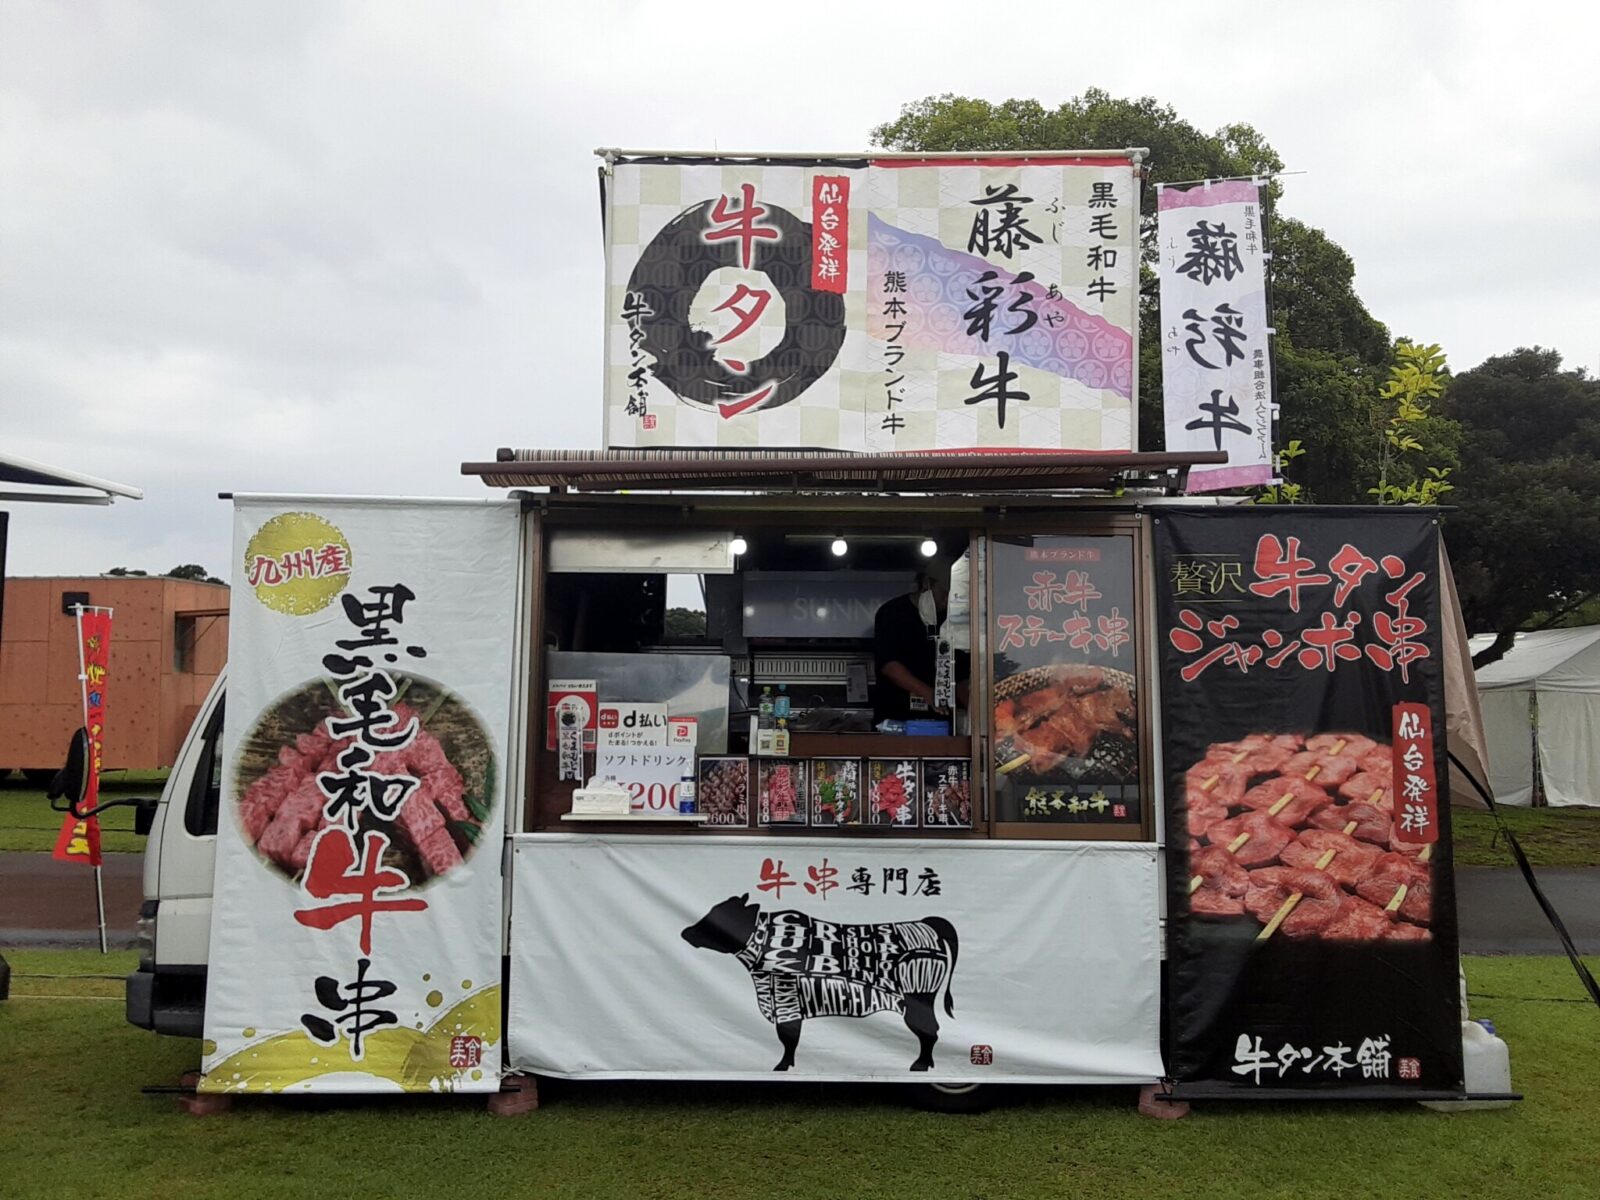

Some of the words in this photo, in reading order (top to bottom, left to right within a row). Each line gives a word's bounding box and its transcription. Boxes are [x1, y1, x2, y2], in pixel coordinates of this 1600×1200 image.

[817, 182, 842, 284] 仙台発祥
[1045, 197, 1066, 244] ふじ
[1086, 182, 1118, 302] 黒毛和牛
[704, 183, 778, 419] 牛タン
[963, 183, 1044, 430] 藤彩牛
[1044, 283, 1065, 328] あや
[620, 292, 653, 417] 牛タン本舗
[881, 270, 907, 435] 熊本ブランド牛
[248, 544, 350, 587] 九州産
[1023, 569, 1103, 613] 赤牛
[1170, 560, 1247, 597] 贅沢
[1249, 533, 1426, 613] 牛タン
[793, 597, 881, 621] SUNN
[997, 606, 1130, 658] ステーキ串
[1169, 598, 1430, 684] ジャンボ串
[623, 709, 668, 728] d払い
[605, 755, 687, 766] ソフトドリンク
[1398, 711, 1432, 836] 仙台発祥
[293, 583, 428, 1056] 黒毛和牛串
[617, 782, 681, 810] 200
[757, 858, 942, 900] 牛串専門店
[738, 917, 768, 969] NECK
[759, 912, 808, 973] CHUCK
[809, 920, 842, 974] RIB
[846, 926, 860, 978] SHORT
[860, 926, 875, 984] LOIN
[878, 924, 900, 991] SIRLOIN
[896, 922, 942, 952] RUMP
[753, 974, 774, 1022] SHANK
[774, 975, 802, 1024] BRISKET
[800, 977, 848, 1018] PLATE
[848, 982, 903, 1017] FLANK
[899, 958, 946, 994] ROUND
[1231, 1032, 1393, 1085] 牛タン本舗
